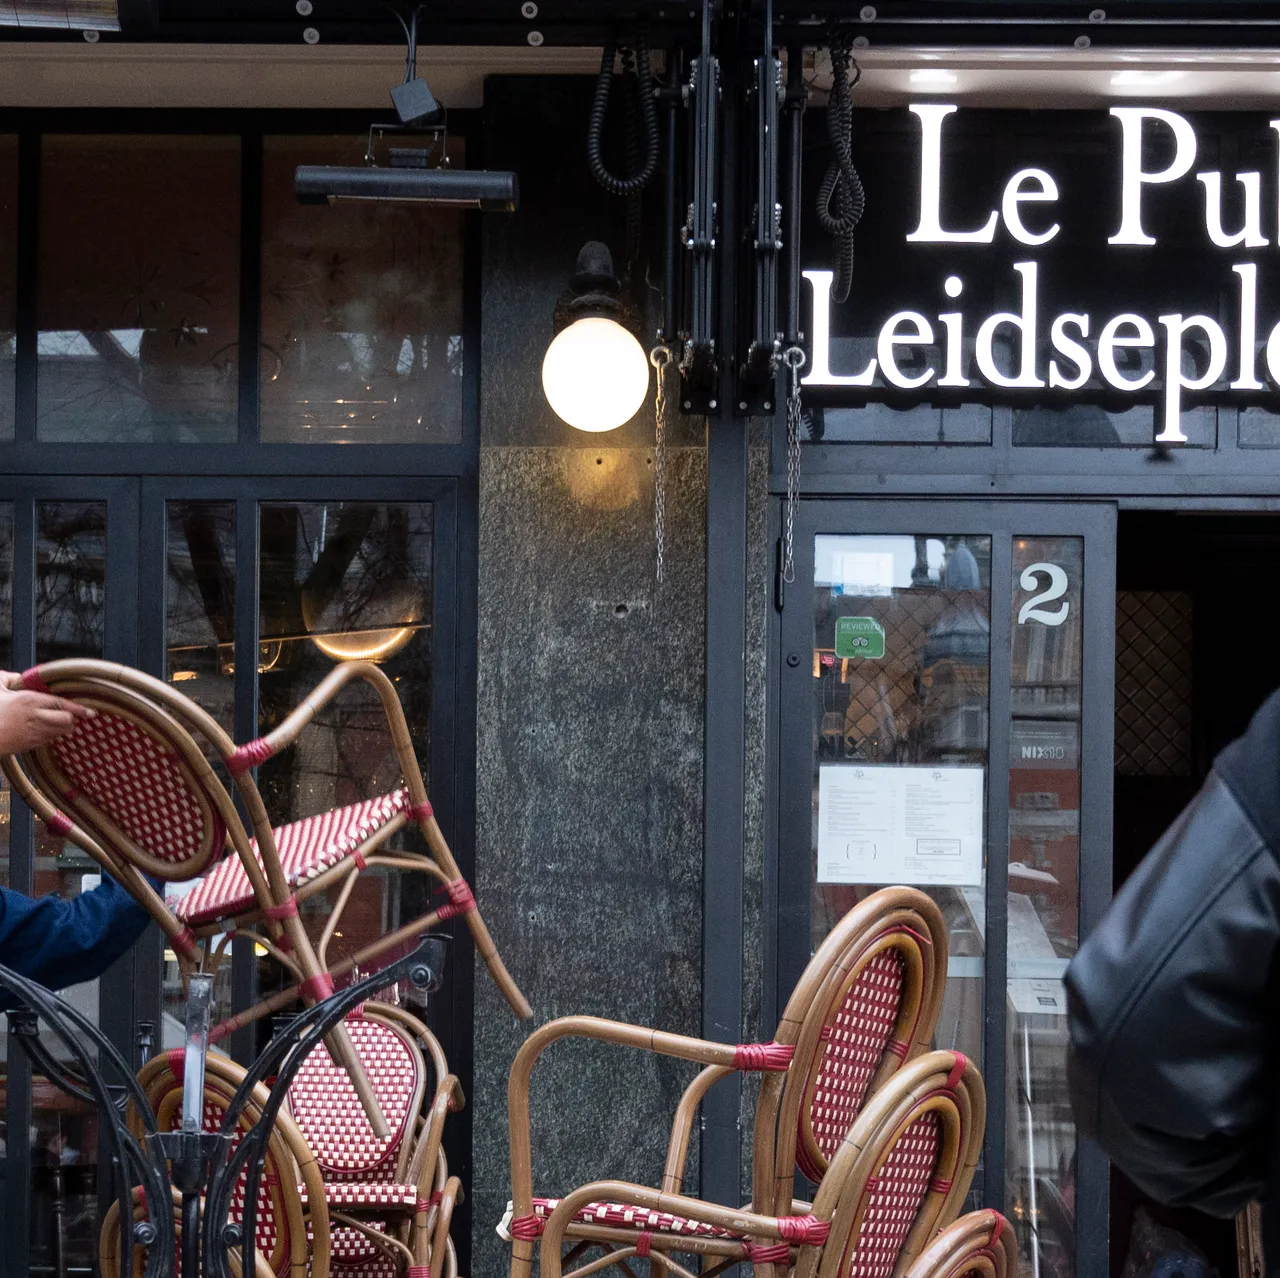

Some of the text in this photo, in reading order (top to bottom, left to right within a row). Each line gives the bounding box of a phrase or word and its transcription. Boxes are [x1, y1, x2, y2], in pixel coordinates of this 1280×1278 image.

[907, 105, 1059, 245] Le
[1018, 563, 1069, 625] 2
[1022, 746, 1064, 759] NIX18
